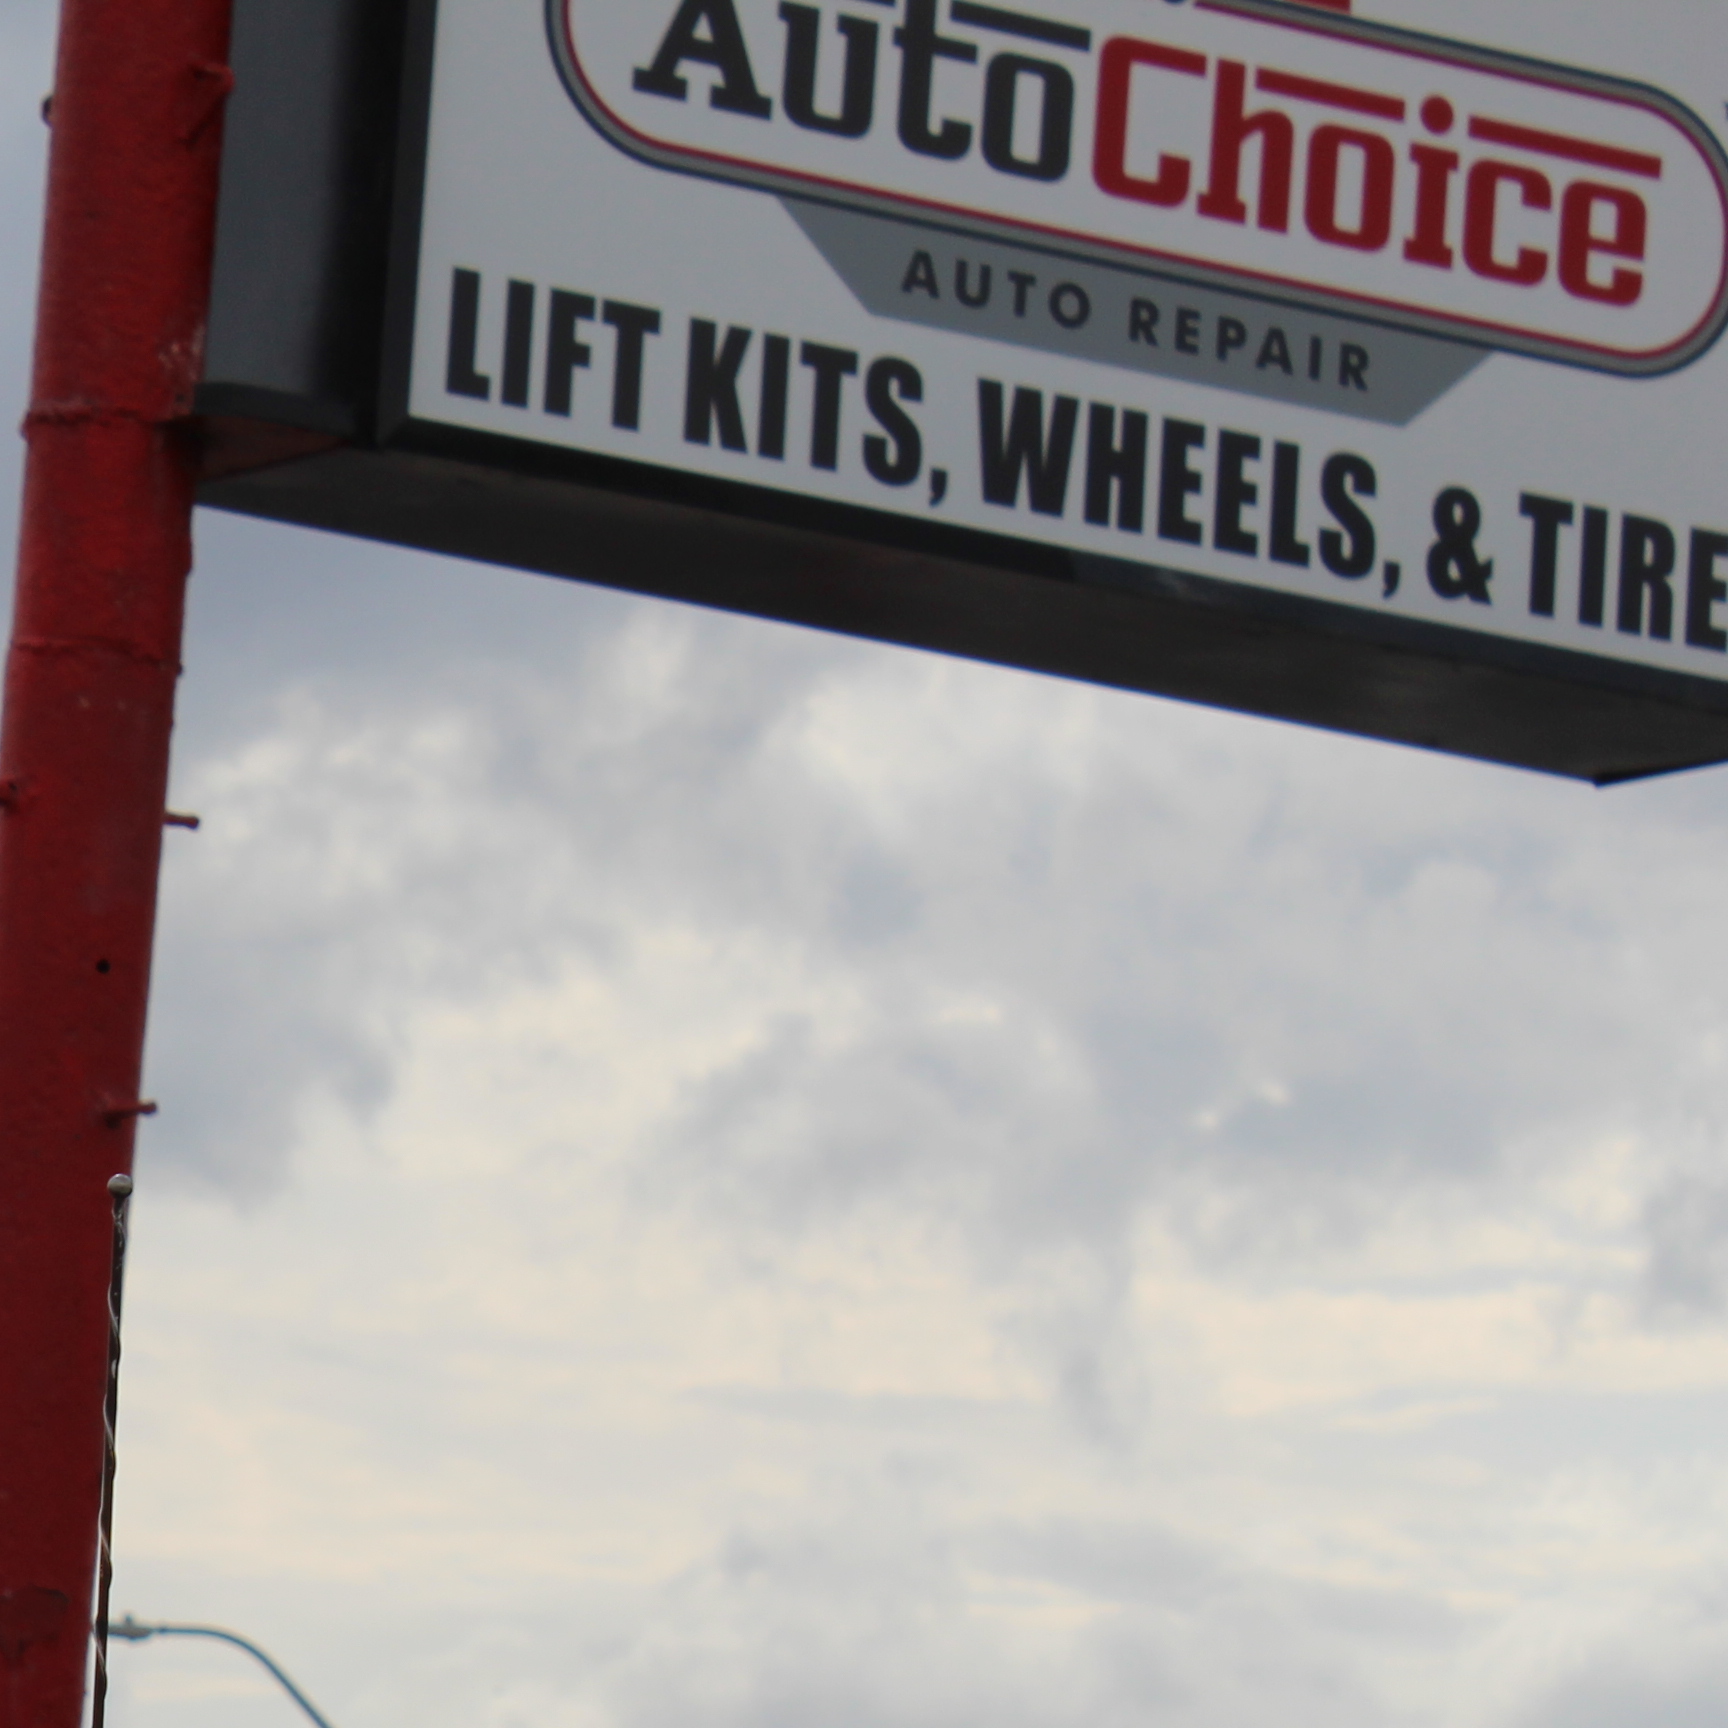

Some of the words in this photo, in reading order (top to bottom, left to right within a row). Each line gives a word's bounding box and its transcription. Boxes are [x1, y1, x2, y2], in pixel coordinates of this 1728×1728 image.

[632, 0, 1660, 308] AutoChoice
[446, 265, 661, 432] LIFT
[683, 317, 948, 506] KITS,
[977, 376, 1401, 600] WHEELS,
[1426, 485, 1494, 606] &
[1518, 491, 1728, 653] TIRE
[900, 248, 1091, 330] AUTO
[1128, 295, 1371, 392] REPAIR
